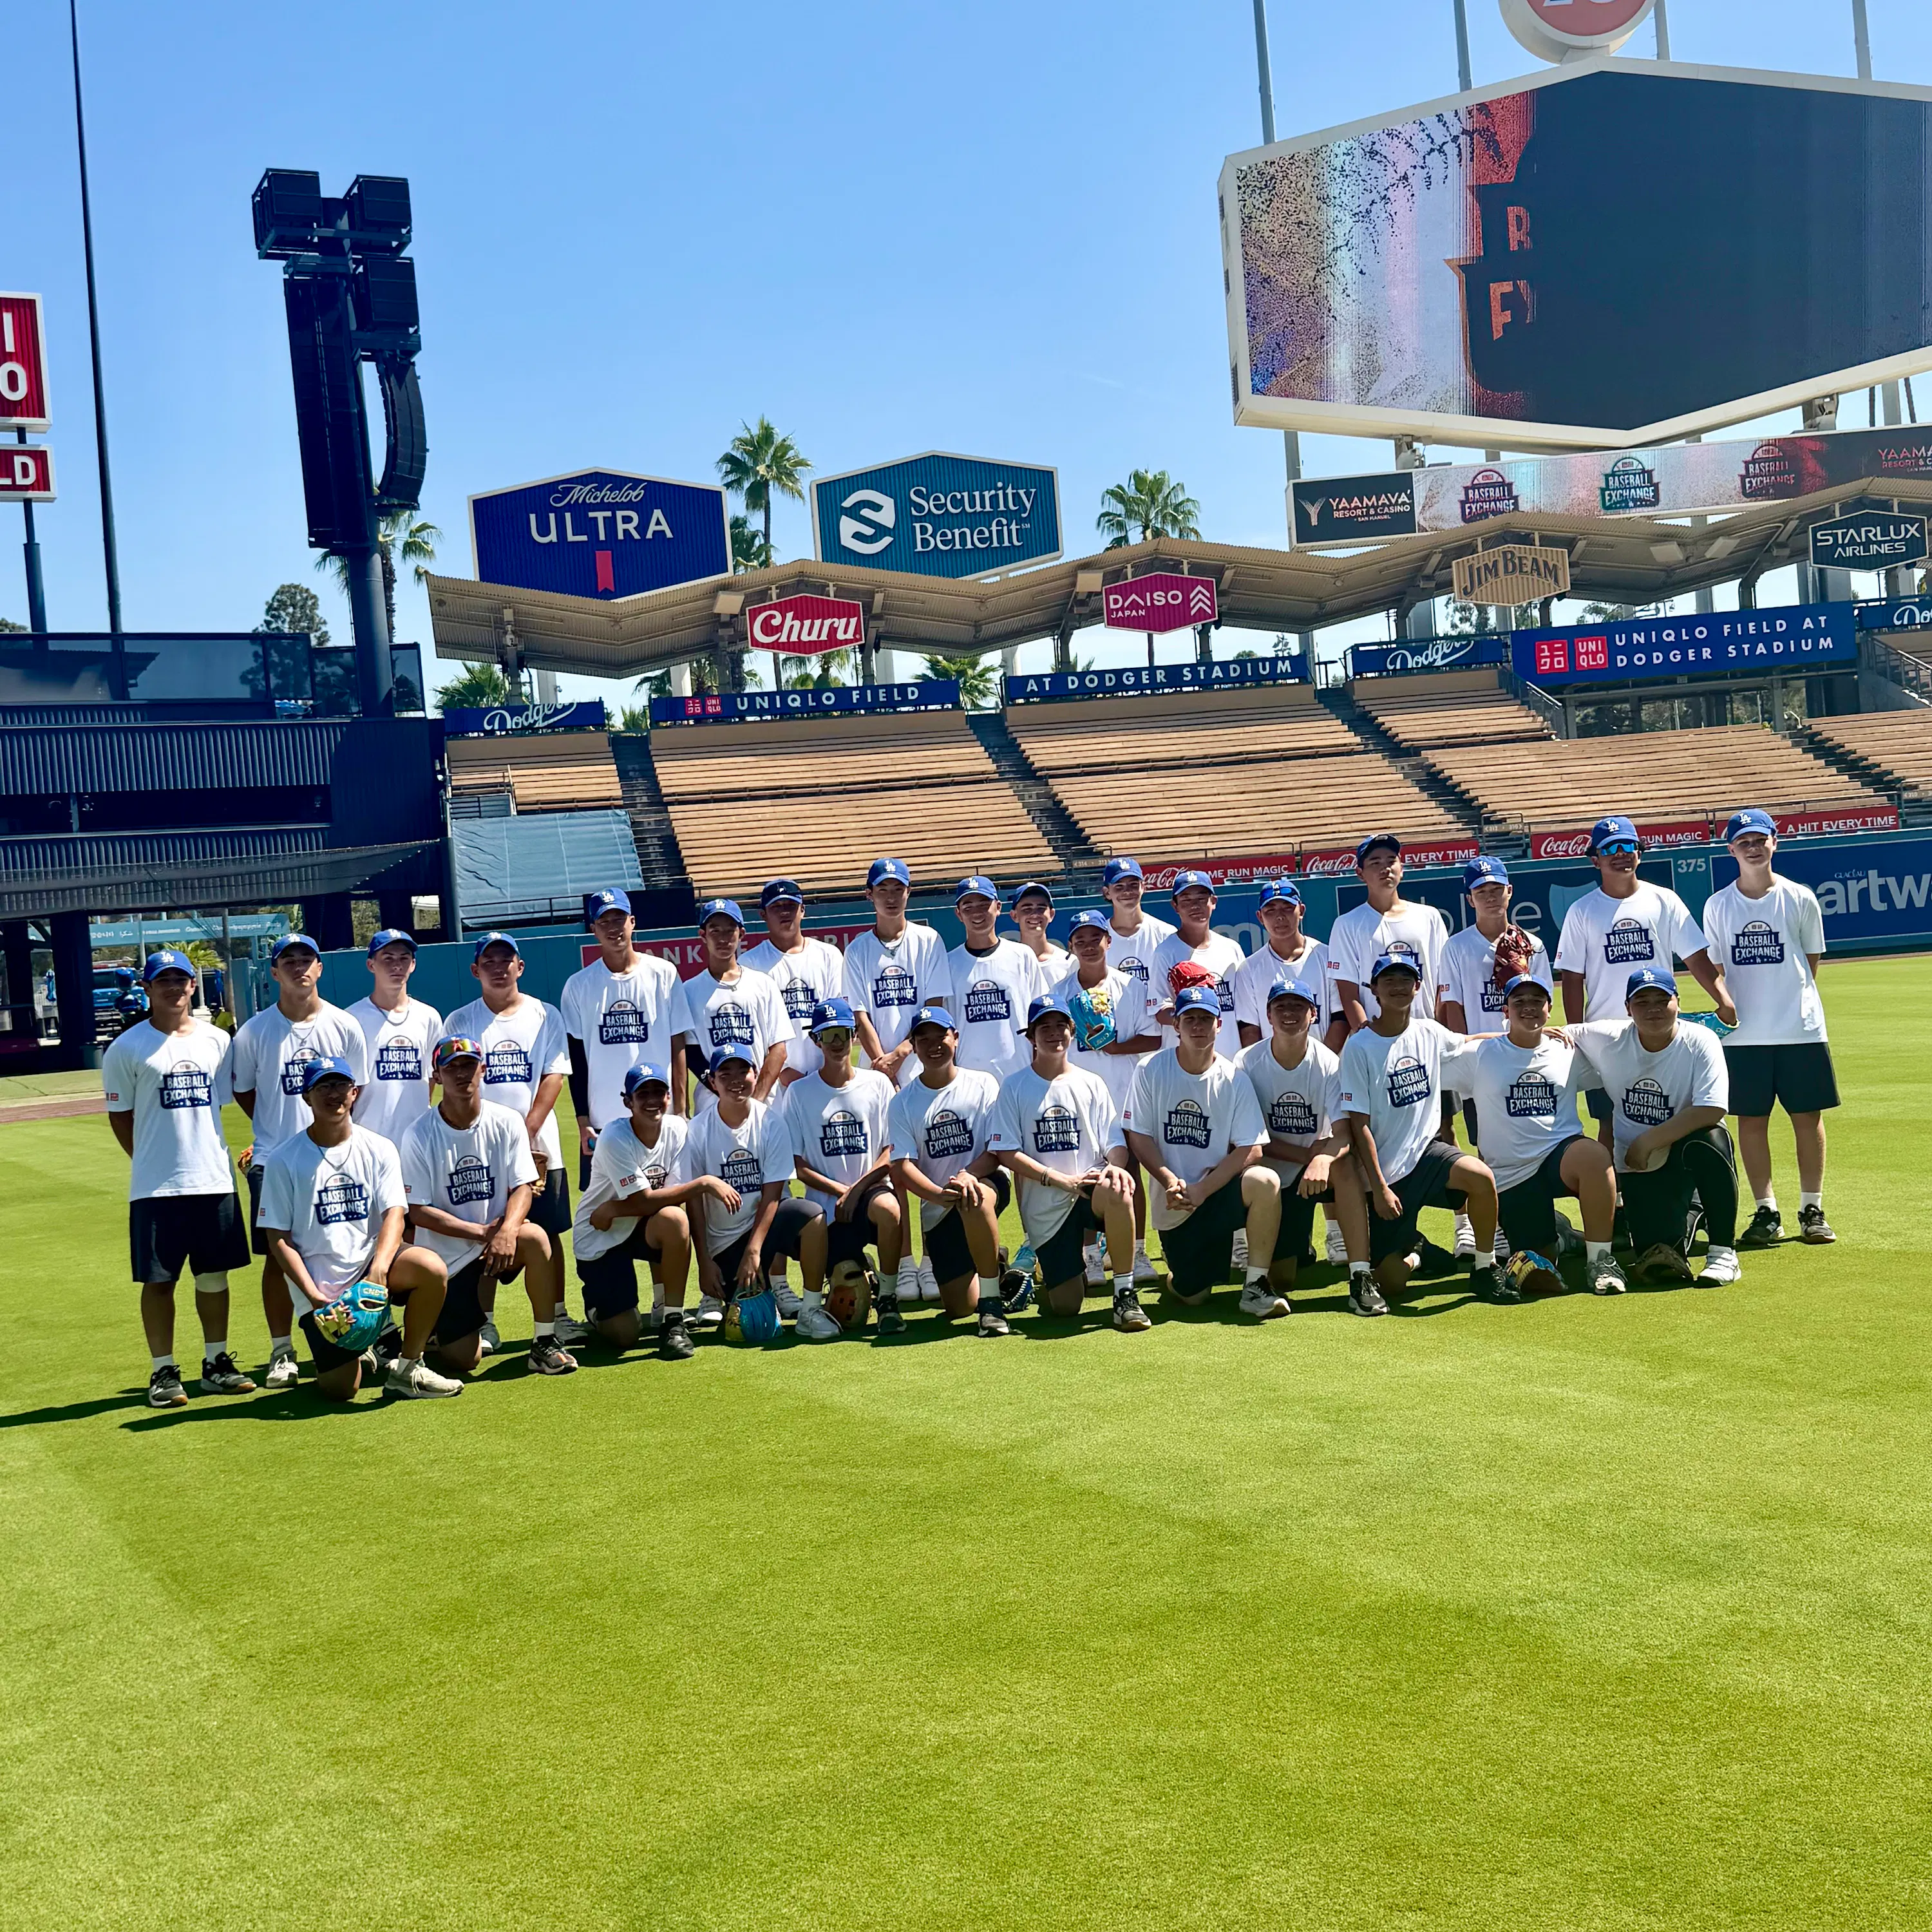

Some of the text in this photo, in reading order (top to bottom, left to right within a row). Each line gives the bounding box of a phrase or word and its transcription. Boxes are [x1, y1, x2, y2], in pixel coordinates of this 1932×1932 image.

[1748, 461, 1788, 476] BASEBALL
[1882, 460, 1915, 469] RESORT
[1608, 473, 1650, 489] BASEBALL
[1745, 475, 1795, 493] EXCHANGE
[550, 482, 647, 507] Michelob
[910, 482, 1036, 517] Security
[1468, 487, 1508, 501] BASEBALL
[1605, 487, 1655, 507] EXCHANGE
[1333, 508, 1367, 518] RESORT
[1377, 505, 1411, 514] CASINO
[1464, 500, 1515, 519] EXCHANGE
[529, 509, 674, 544] ULTRA
[1816, 522, 1921, 546] STARLUX
[913, 518, 1024, 552] Benefit
[1834, 542, 1906, 558] AIRLINES
[1462, 550, 1561, 598] JIM BEAM
[1111, 609, 1146, 618] JAPAN
[753, 610, 858, 643] Churu
[1615, 616, 1827, 646] UNIQLO FIELD AT
[1578, 640, 1602, 654] UNI
[1616, 636, 1833, 667] DODGER STADIUM
[1580, 652, 1605, 666] QLO
[1027, 659, 1292, 692] AT DODGER STADIUM
[737, 687, 919, 710] UNIQLO FIELD
[1786, 816, 1896, 833] A HIT EVERY TIME
[1666, 831, 1702, 843] MAGIC
[1306, 848, 1477, 872] Coca-Col EVERY TIME
[1677, 858, 1706, 873] 375
[1227, 867, 1249, 876] RUN
[1253, 865, 1288, 875] MAGIC
[1816, 869, 1932, 915] artw
[1609, 930, 1647, 944] BASEBALL
[1739, 934, 1777, 947] BASEBALL
[1609, 943, 1651, 960] EXCHANGE
[1735, 947, 1781, 961] EXCHANGE
[878, 978, 912, 990] BASEBALL
[877, 989, 915, 1003] EXCHANGE
[971, 993, 1004, 1005] BASEBALL
[969, 1003, 1008, 1018] EXCHANGE
[606, 1014, 641, 1026] BASEBALL
[714, 1016, 748, 1028] BASEBALL
[603, 1025, 645, 1041] EXCHANGE
[713, 1027, 752, 1041] EXCHANGE
[383, 1050, 417, 1063] BASEBALL
[489, 1054, 526, 1066] BASEBALL
[379, 1063, 421, 1076] EXCHANGE
[486, 1065, 530, 1077] EXCHANGE
[167, 1075, 207, 1088] BASEBALL
[1393, 1071, 1426, 1087] BASEBALL
[1392, 1083, 1428, 1102] EXCHANGE
[1513, 1086, 1552, 1098] BASEBALL
[1510, 1097, 1555, 1113] EXCHANGE
[1628, 1092, 1667, 1108] BASEBALL
[1274, 1105, 1310, 1117] BASEBALL
[1625, 1104, 1670, 1121] EXCHANGE
[1039, 1121, 1076, 1133] BASEBALL
[1171, 1113, 1205, 1130] BASEBALL
[1272, 1115, 1314, 1129] EXCHANGE
[826, 1124, 861, 1137] BASEBALL
[931, 1123, 966, 1140] BASEBALL
[1167, 1125, 1208, 1145] EXCHANGE
[824, 1137, 866, 1150] EXCHANGE
[929, 1135, 971, 1153] EXCHANGE
[1037, 1132, 1079, 1147] EXCHANGE
[453, 1170, 488, 1184] BASEBALL
[724, 1162, 759, 1177] BASEBALL
[321, 1188, 362, 1202] BASEBALL
[451, 1181, 493, 1198] EXCHANGE
[319, 1200, 366, 1217] EXCHANGE
